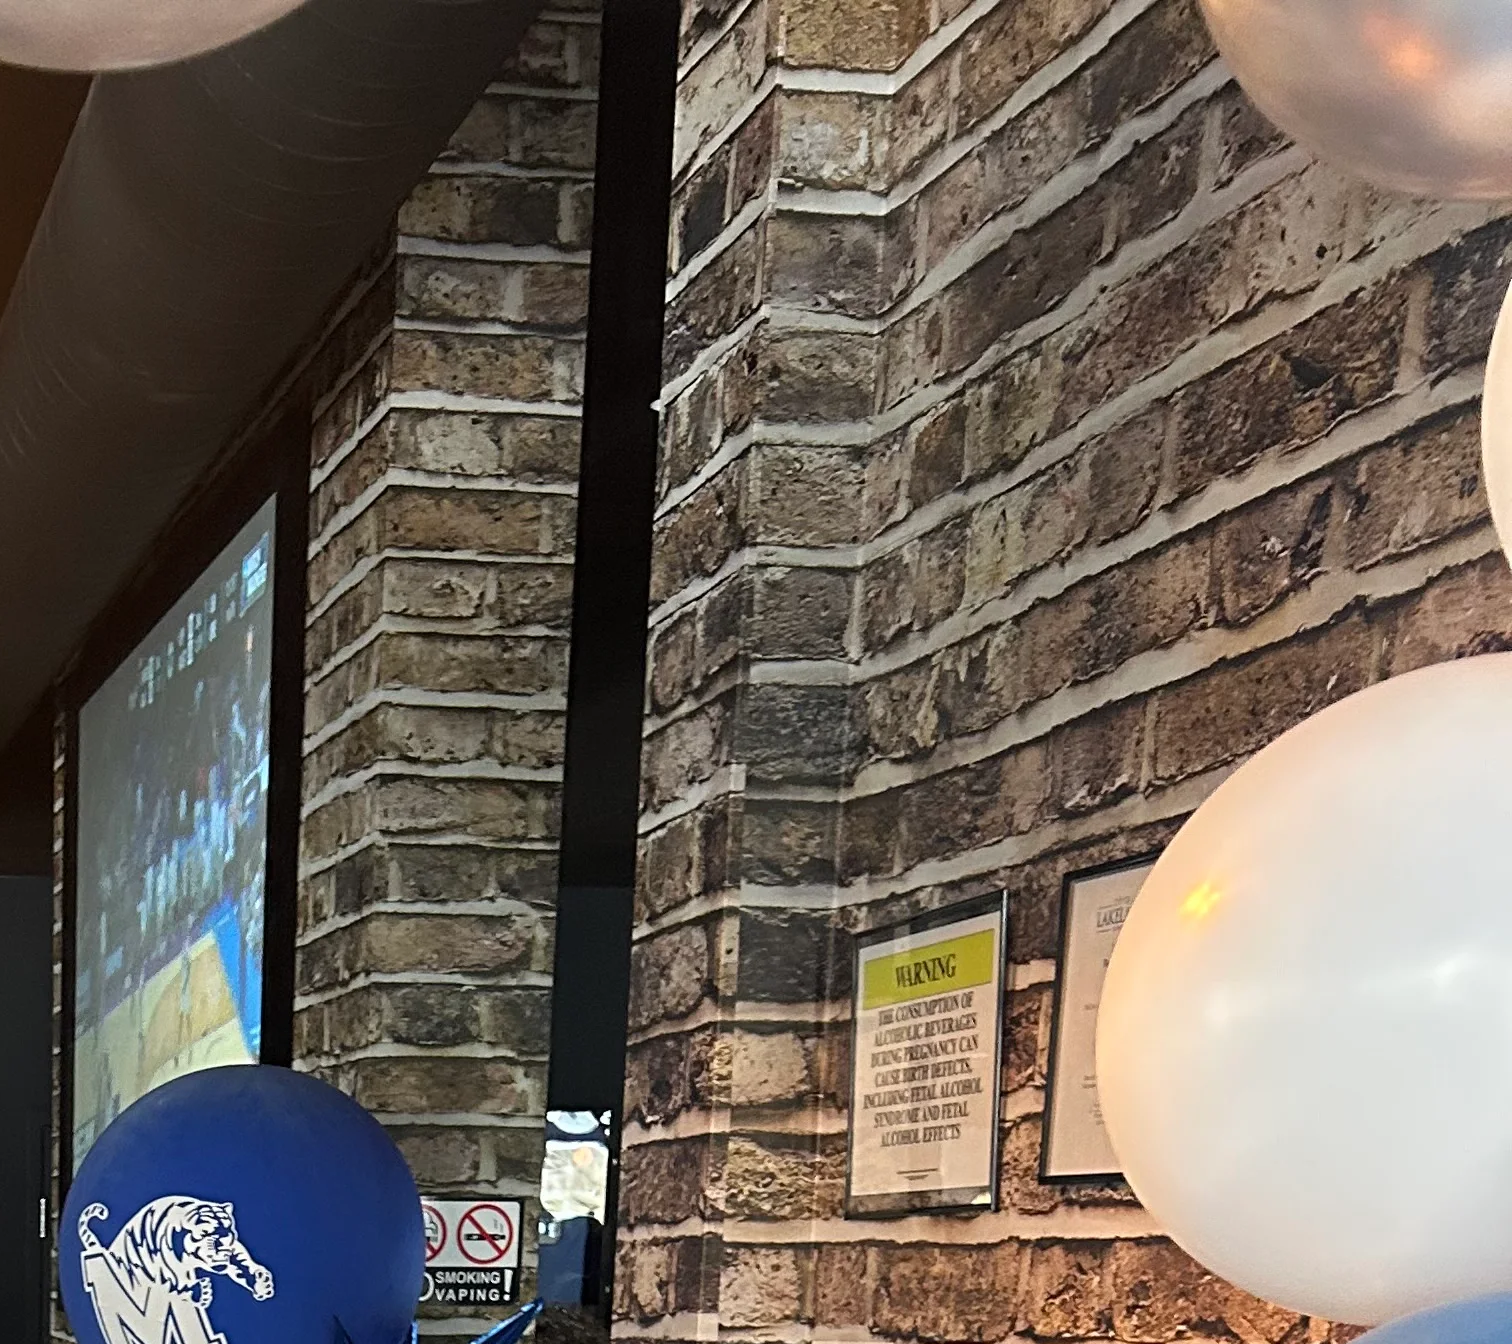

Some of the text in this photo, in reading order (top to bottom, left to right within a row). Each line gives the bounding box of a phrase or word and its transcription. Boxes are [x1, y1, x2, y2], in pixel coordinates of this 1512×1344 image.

[896, 954, 956, 987] WARNING
[878, 991, 974, 1026] THE CONSUMPTION OF
[874, 1012, 977, 1047] ALCOHOLIC BEVERAGES
[871, 1034, 979, 1068] DURING PREGNANCY CAN
[874, 1069, 901, 1088] CAUSE
[903, 1064, 928, 1083] BIRTH
[863, 1077, 983, 1110] INCLUDING FETAL ALCOHOL
[874, 1101, 970, 1128] SYNDROME AND FETAL
[880, 1123, 961, 1148] ALCOHOL EFFECTS
[435, 1271, 501, 1284] SMOKING
